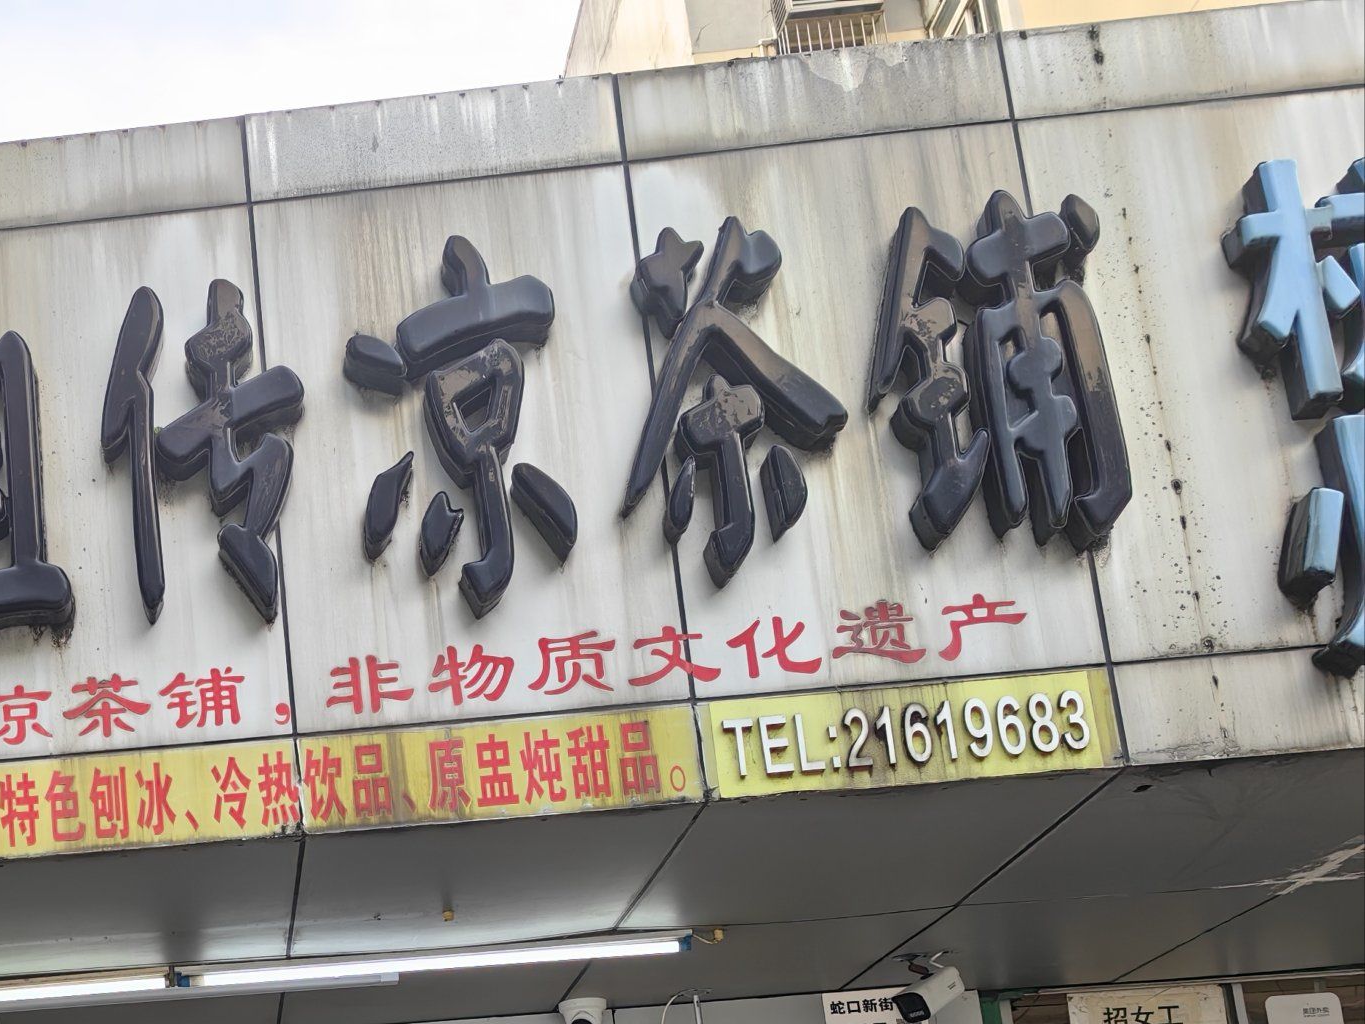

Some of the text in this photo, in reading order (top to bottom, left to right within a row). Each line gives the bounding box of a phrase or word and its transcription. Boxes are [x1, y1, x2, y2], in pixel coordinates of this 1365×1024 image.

[722, 690, 1091, 778] TEL:21619683
[830, 997, 894, 1015] 蛇口新街
